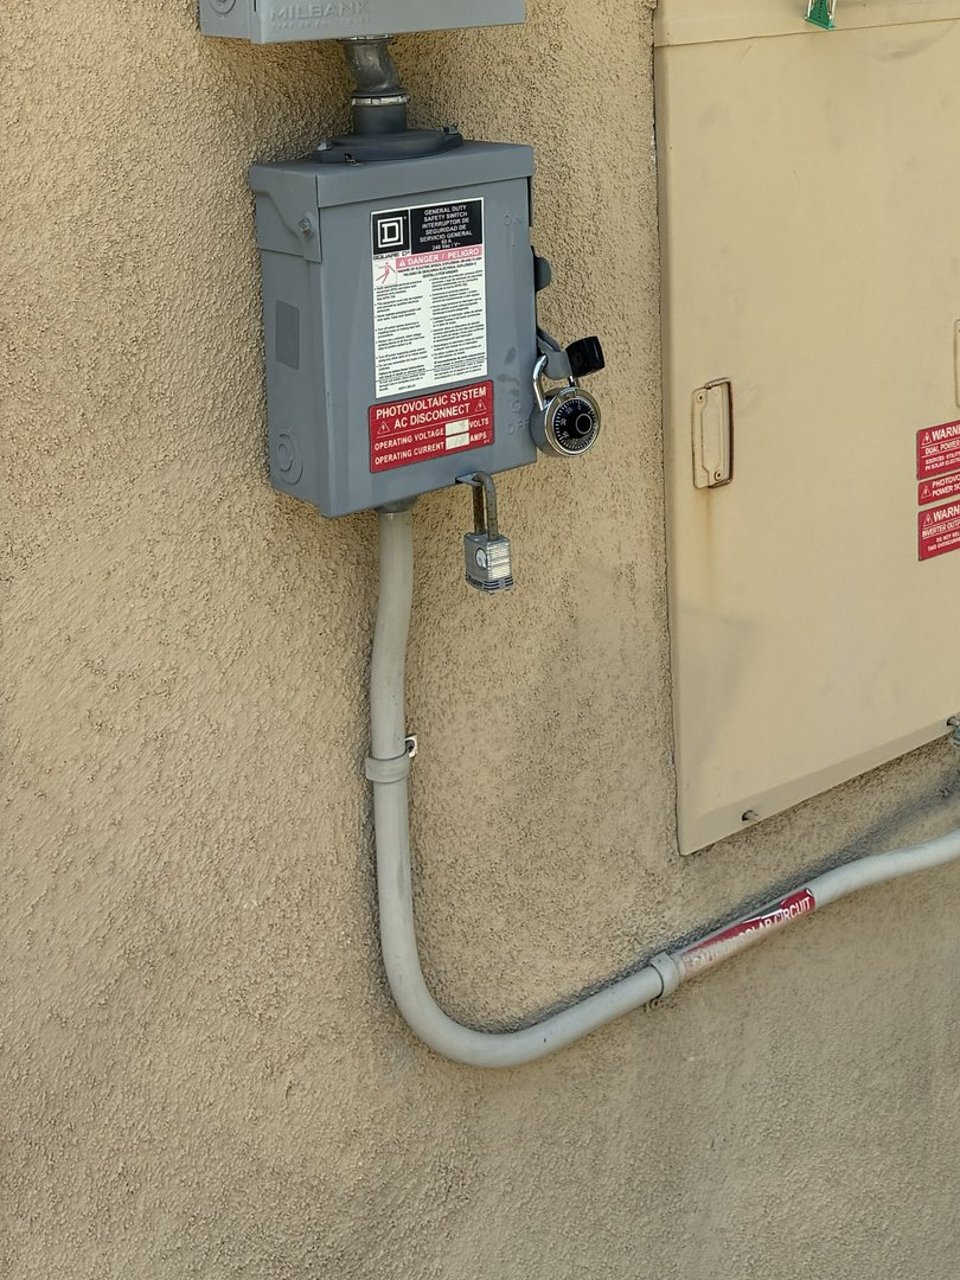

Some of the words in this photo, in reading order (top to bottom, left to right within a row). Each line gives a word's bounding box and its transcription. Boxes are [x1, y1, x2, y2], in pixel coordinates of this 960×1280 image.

[270, 0, 370, 21] MILBANK
[424, 208, 451, 216] GENERAL
[424, 214, 445, 222] SAFETY
[446, 211, 468, 219] SWITCH
[422, 219, 461, 229] INTERRUPTOR
[425, 226, 458, 235] SEGURIDAD
[419, 234, 446, 243] SERVICIO
[447, 230, 473, 238] GENERAL
[408, 253, 440, 265] DANGER
[448, 248, 480, 260] PELIGRO
[376, 397, 448, 420] PHOTOVOLTAIC
[449, 387, 487, 403] SYSTEM
[394, 418, 408, 429] AC
[410, 402, 471, 426] DISCONNECT
[374, 436, 412, 451] OPERATING
[414, 427, 445, 442] VOLTAGE
[469, 417, 489, 429] VOLTS
[374, 451, 412, 466] OPERATING
[414, 441, 445, 456] CURRENT
[470, 431, 487, 443] AMPS
[925, 445, 940, 455] DUAL
[940, 439, 960, 451] POWER
[932, 485, 954, 497] POWER
[922, 522, 947, 538] INVERTER
[773, 896, 811, 925] CIRCUIT
